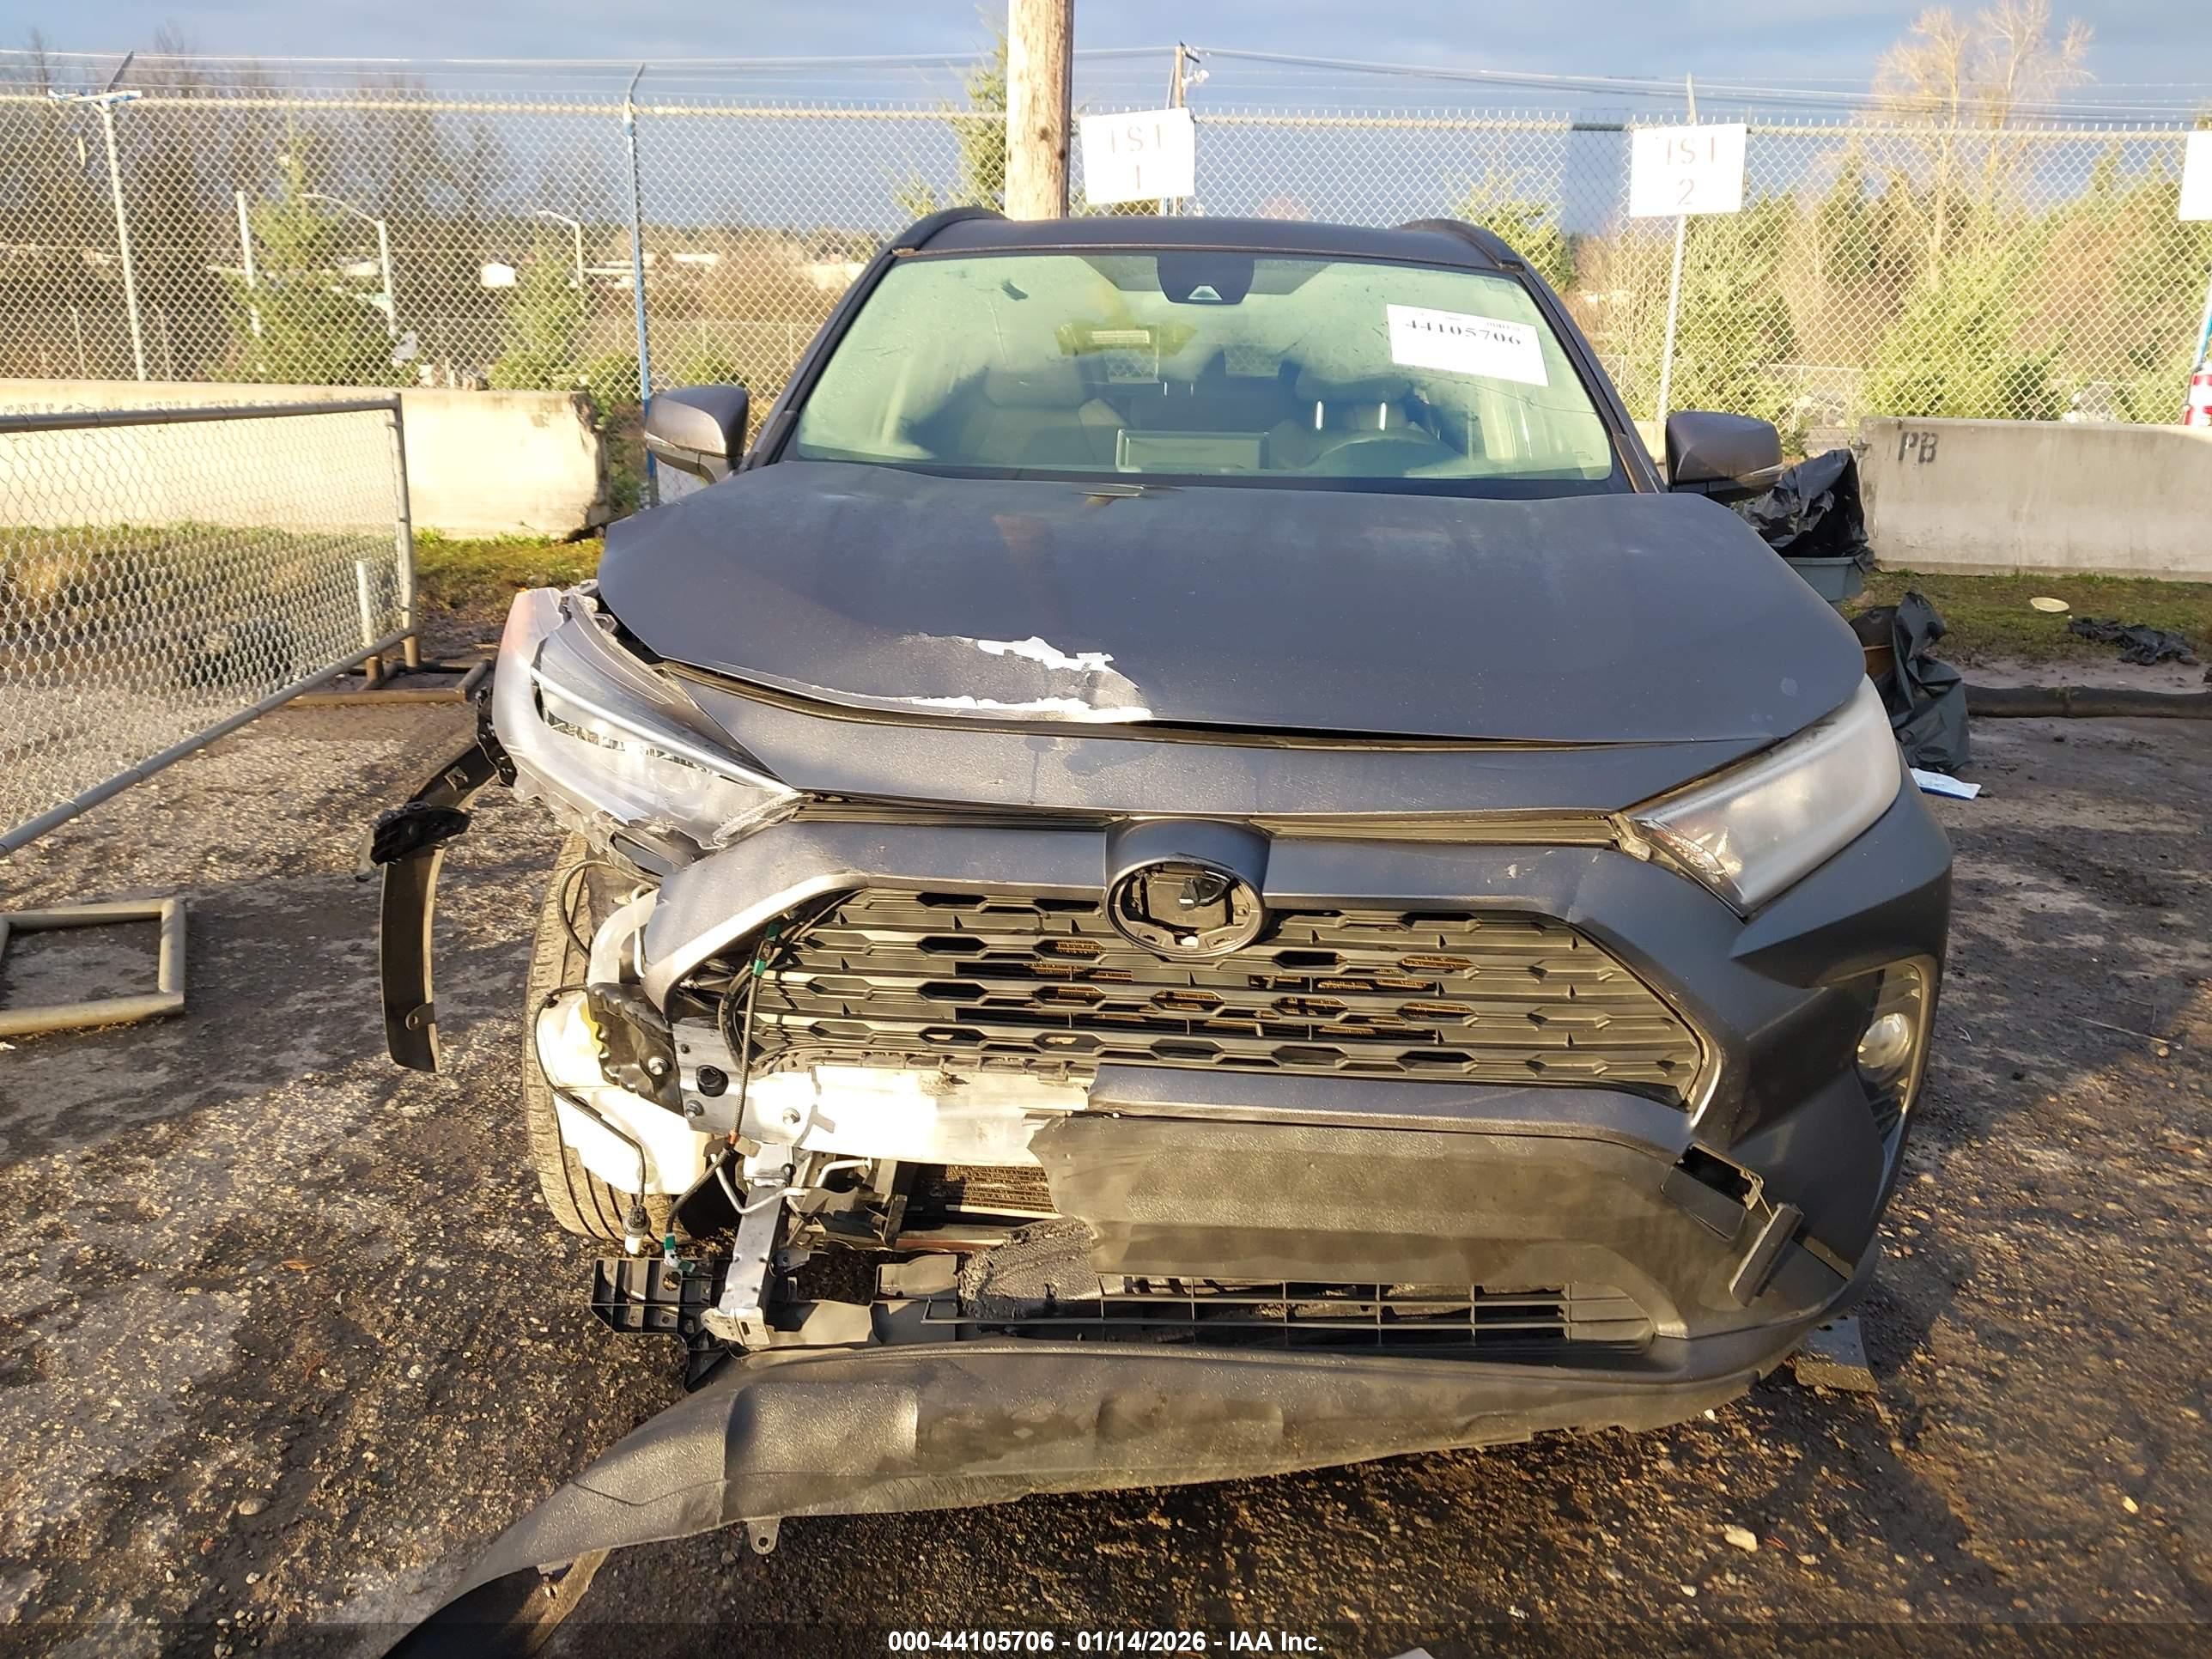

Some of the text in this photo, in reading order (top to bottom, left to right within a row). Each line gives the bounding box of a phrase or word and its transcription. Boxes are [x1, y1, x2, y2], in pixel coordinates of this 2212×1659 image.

[1676, 178, 1695, 207] 2
[1403, 319, 1522, 346] 44105706
[1898, 431, 1939, 464] PB
